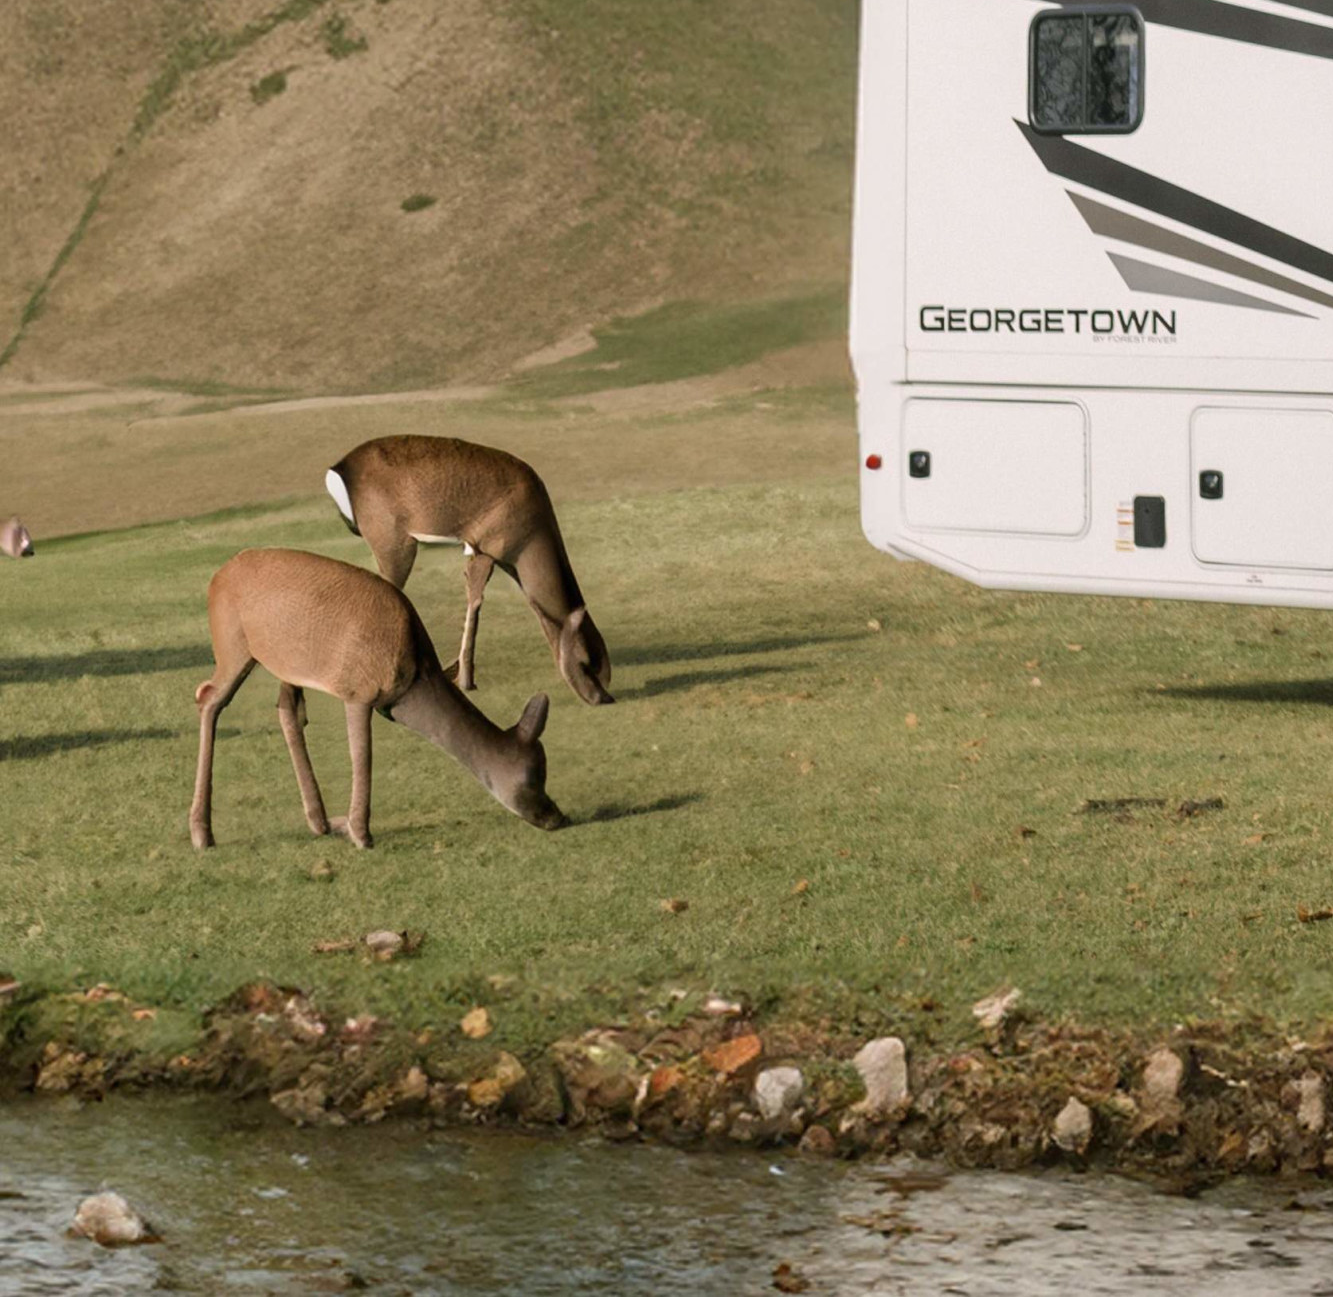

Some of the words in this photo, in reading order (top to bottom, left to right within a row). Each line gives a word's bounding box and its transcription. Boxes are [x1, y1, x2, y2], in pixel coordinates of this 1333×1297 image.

[919, 306, 1176, 334] GEORGETOWN
[1108, 335, 1145, 343] FOREST
[1148, 335, 1177, 344] RIVER
